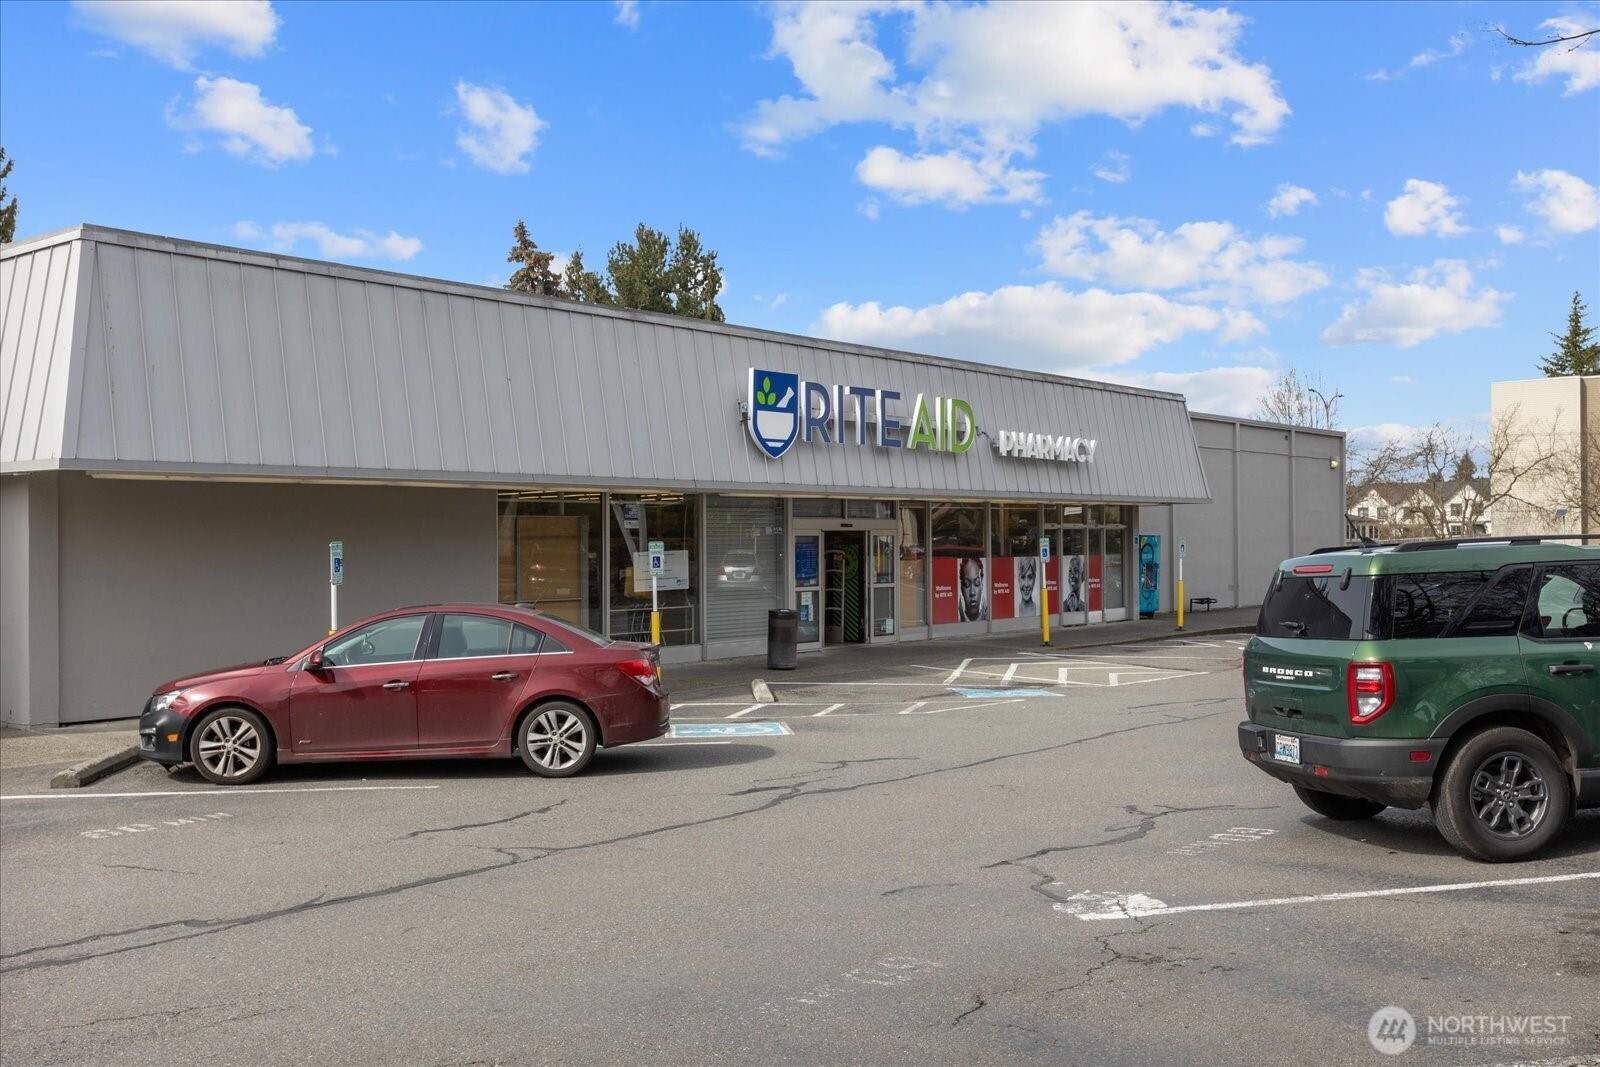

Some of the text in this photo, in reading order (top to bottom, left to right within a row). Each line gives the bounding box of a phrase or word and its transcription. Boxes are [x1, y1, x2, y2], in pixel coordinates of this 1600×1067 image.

[800, 380, 976, 454] RITE AID
[999, 429, 1098, 463] PHARMACY
[1262, 666, 1314, 677] BRONCO
